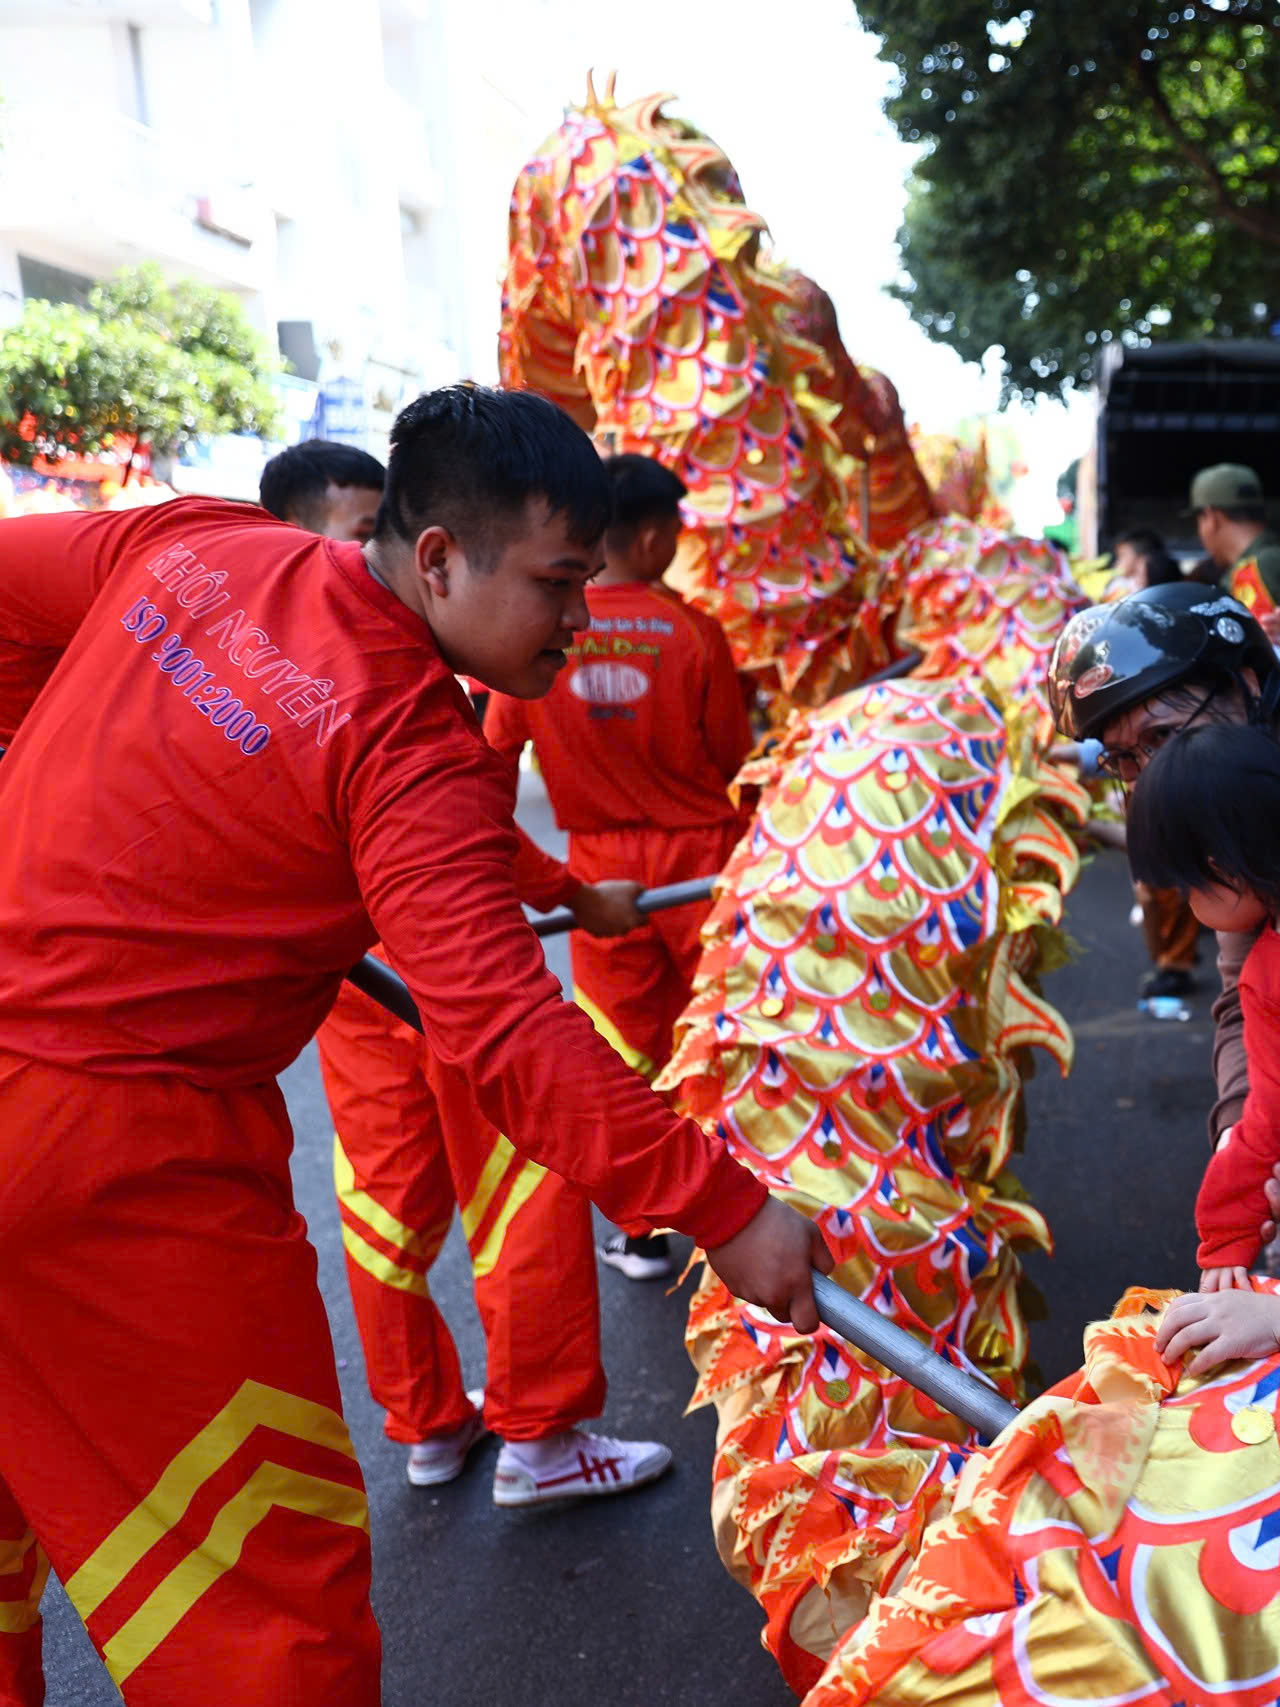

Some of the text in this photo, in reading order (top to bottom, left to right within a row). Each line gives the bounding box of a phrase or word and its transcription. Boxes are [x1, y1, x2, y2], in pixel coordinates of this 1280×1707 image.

[120, 595, 271, 756] ISO 9001:2000
[146, 543, 352, 748] KHÔI NGUYÊN
